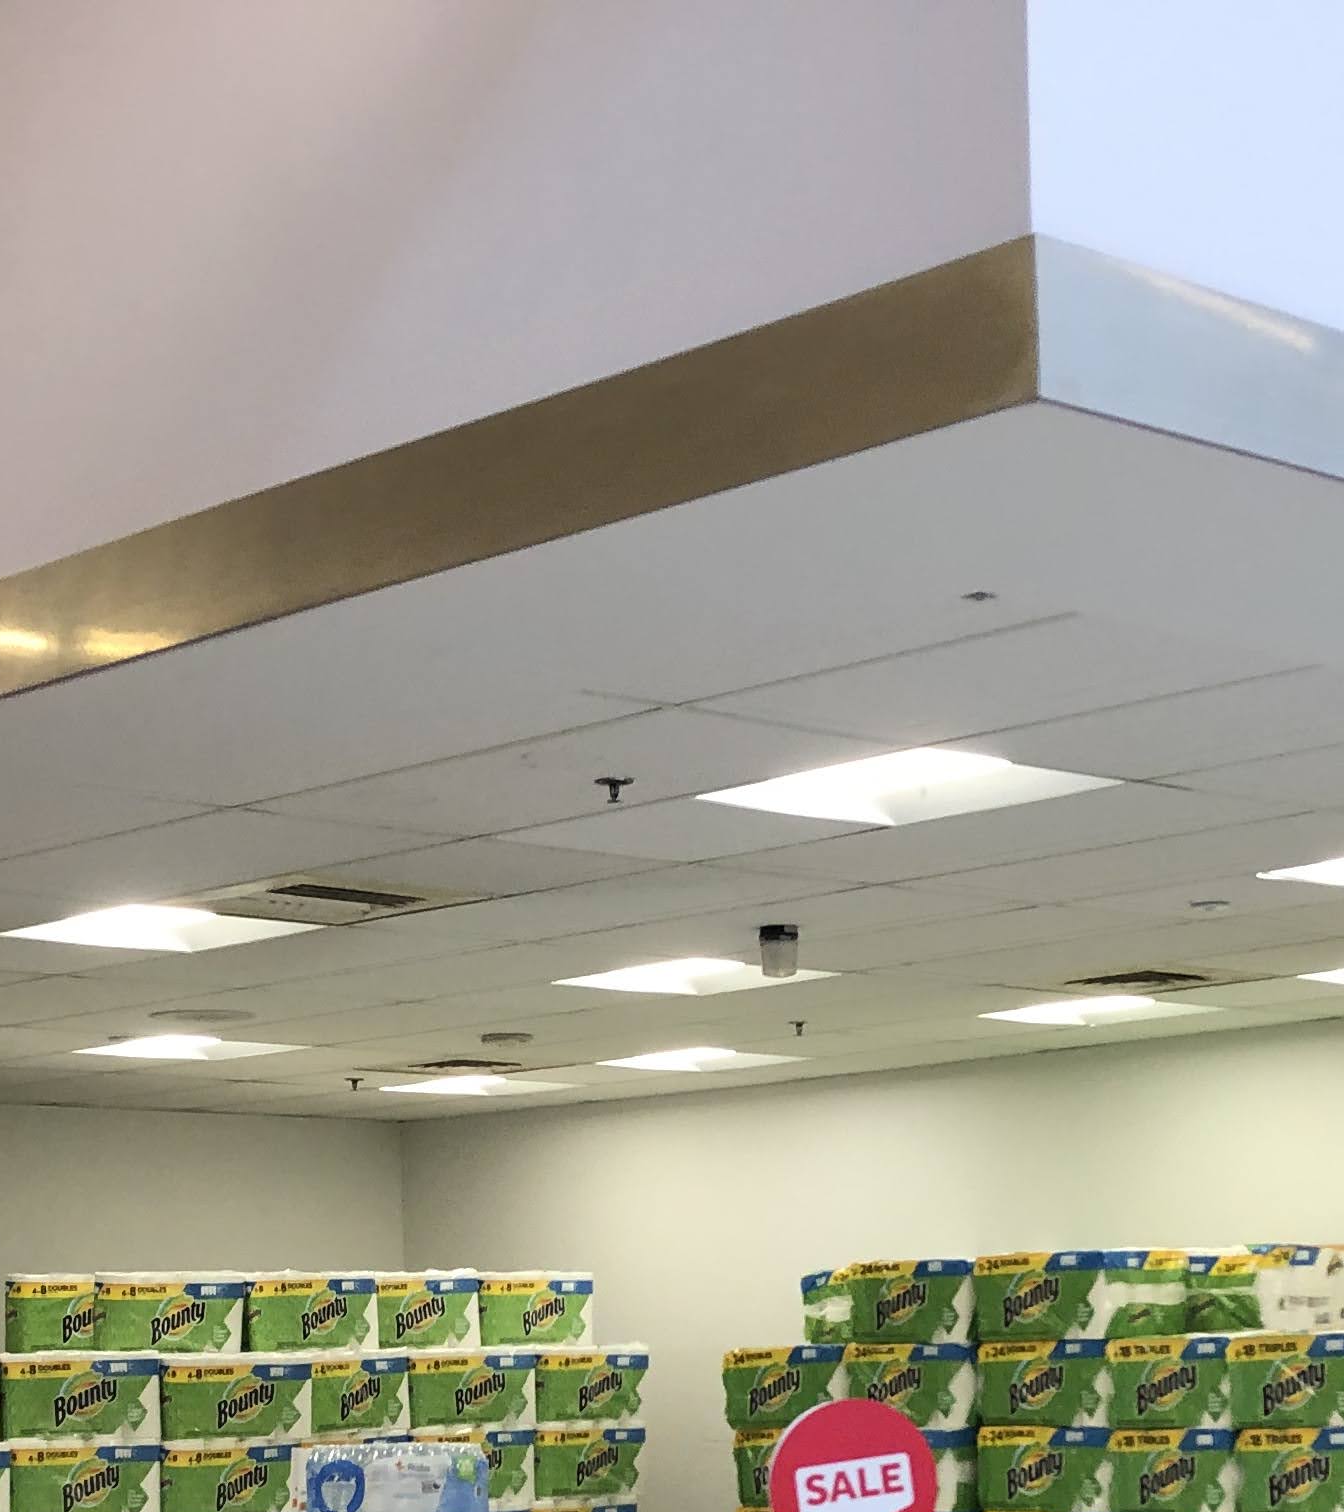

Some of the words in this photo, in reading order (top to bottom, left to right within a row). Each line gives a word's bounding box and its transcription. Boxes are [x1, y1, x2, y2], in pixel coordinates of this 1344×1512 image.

[150, 1301, 205, 1346] Bounty
[301, 1296, 348, 1341] Bounty
[395, 1295, 446, 1339] Bounty
[523, 1295, 566, 1336] Bounty
[875, 1282, 927, 1331] Bounty
[1002, 1277, 1060, 1328] Bounty
[1134, 1345, 1172, 1355] TRIPLES
[1259, 1342, 1298, 1353] TRIPLES
[54, 1378, 118, 1428] Bounty
[217, 1382, 275, 1429] Bounty
[340, 1375, 381, 1421] Bounty
[455, 1371, 506, 1416] Bounty
[578, 1370, 623, 1412] Bounty
[748, 1368, 801, 1417] Bounty
[1009, 1365, 1064, 1415] Bounty
[1136, 1365, 1197, 1416] Bounty
[1262, 1362, 1326, 1417] Bounty
[1138, 1436, 1170, 1446] TRIPLES
[1266, 1434, 1303, 1445] TRIPLES
[216, 1464, 268, 1512] Bounty
[576, 1445, 619, 1487] Bounty
[805, 1462, 905, 1506] SALE
[1007, 1451, 1063, 1500] Bounty
[1139, 1456, 1196, 1505] Bounty
[1268, 1455, 1330, 1507] Bounty
